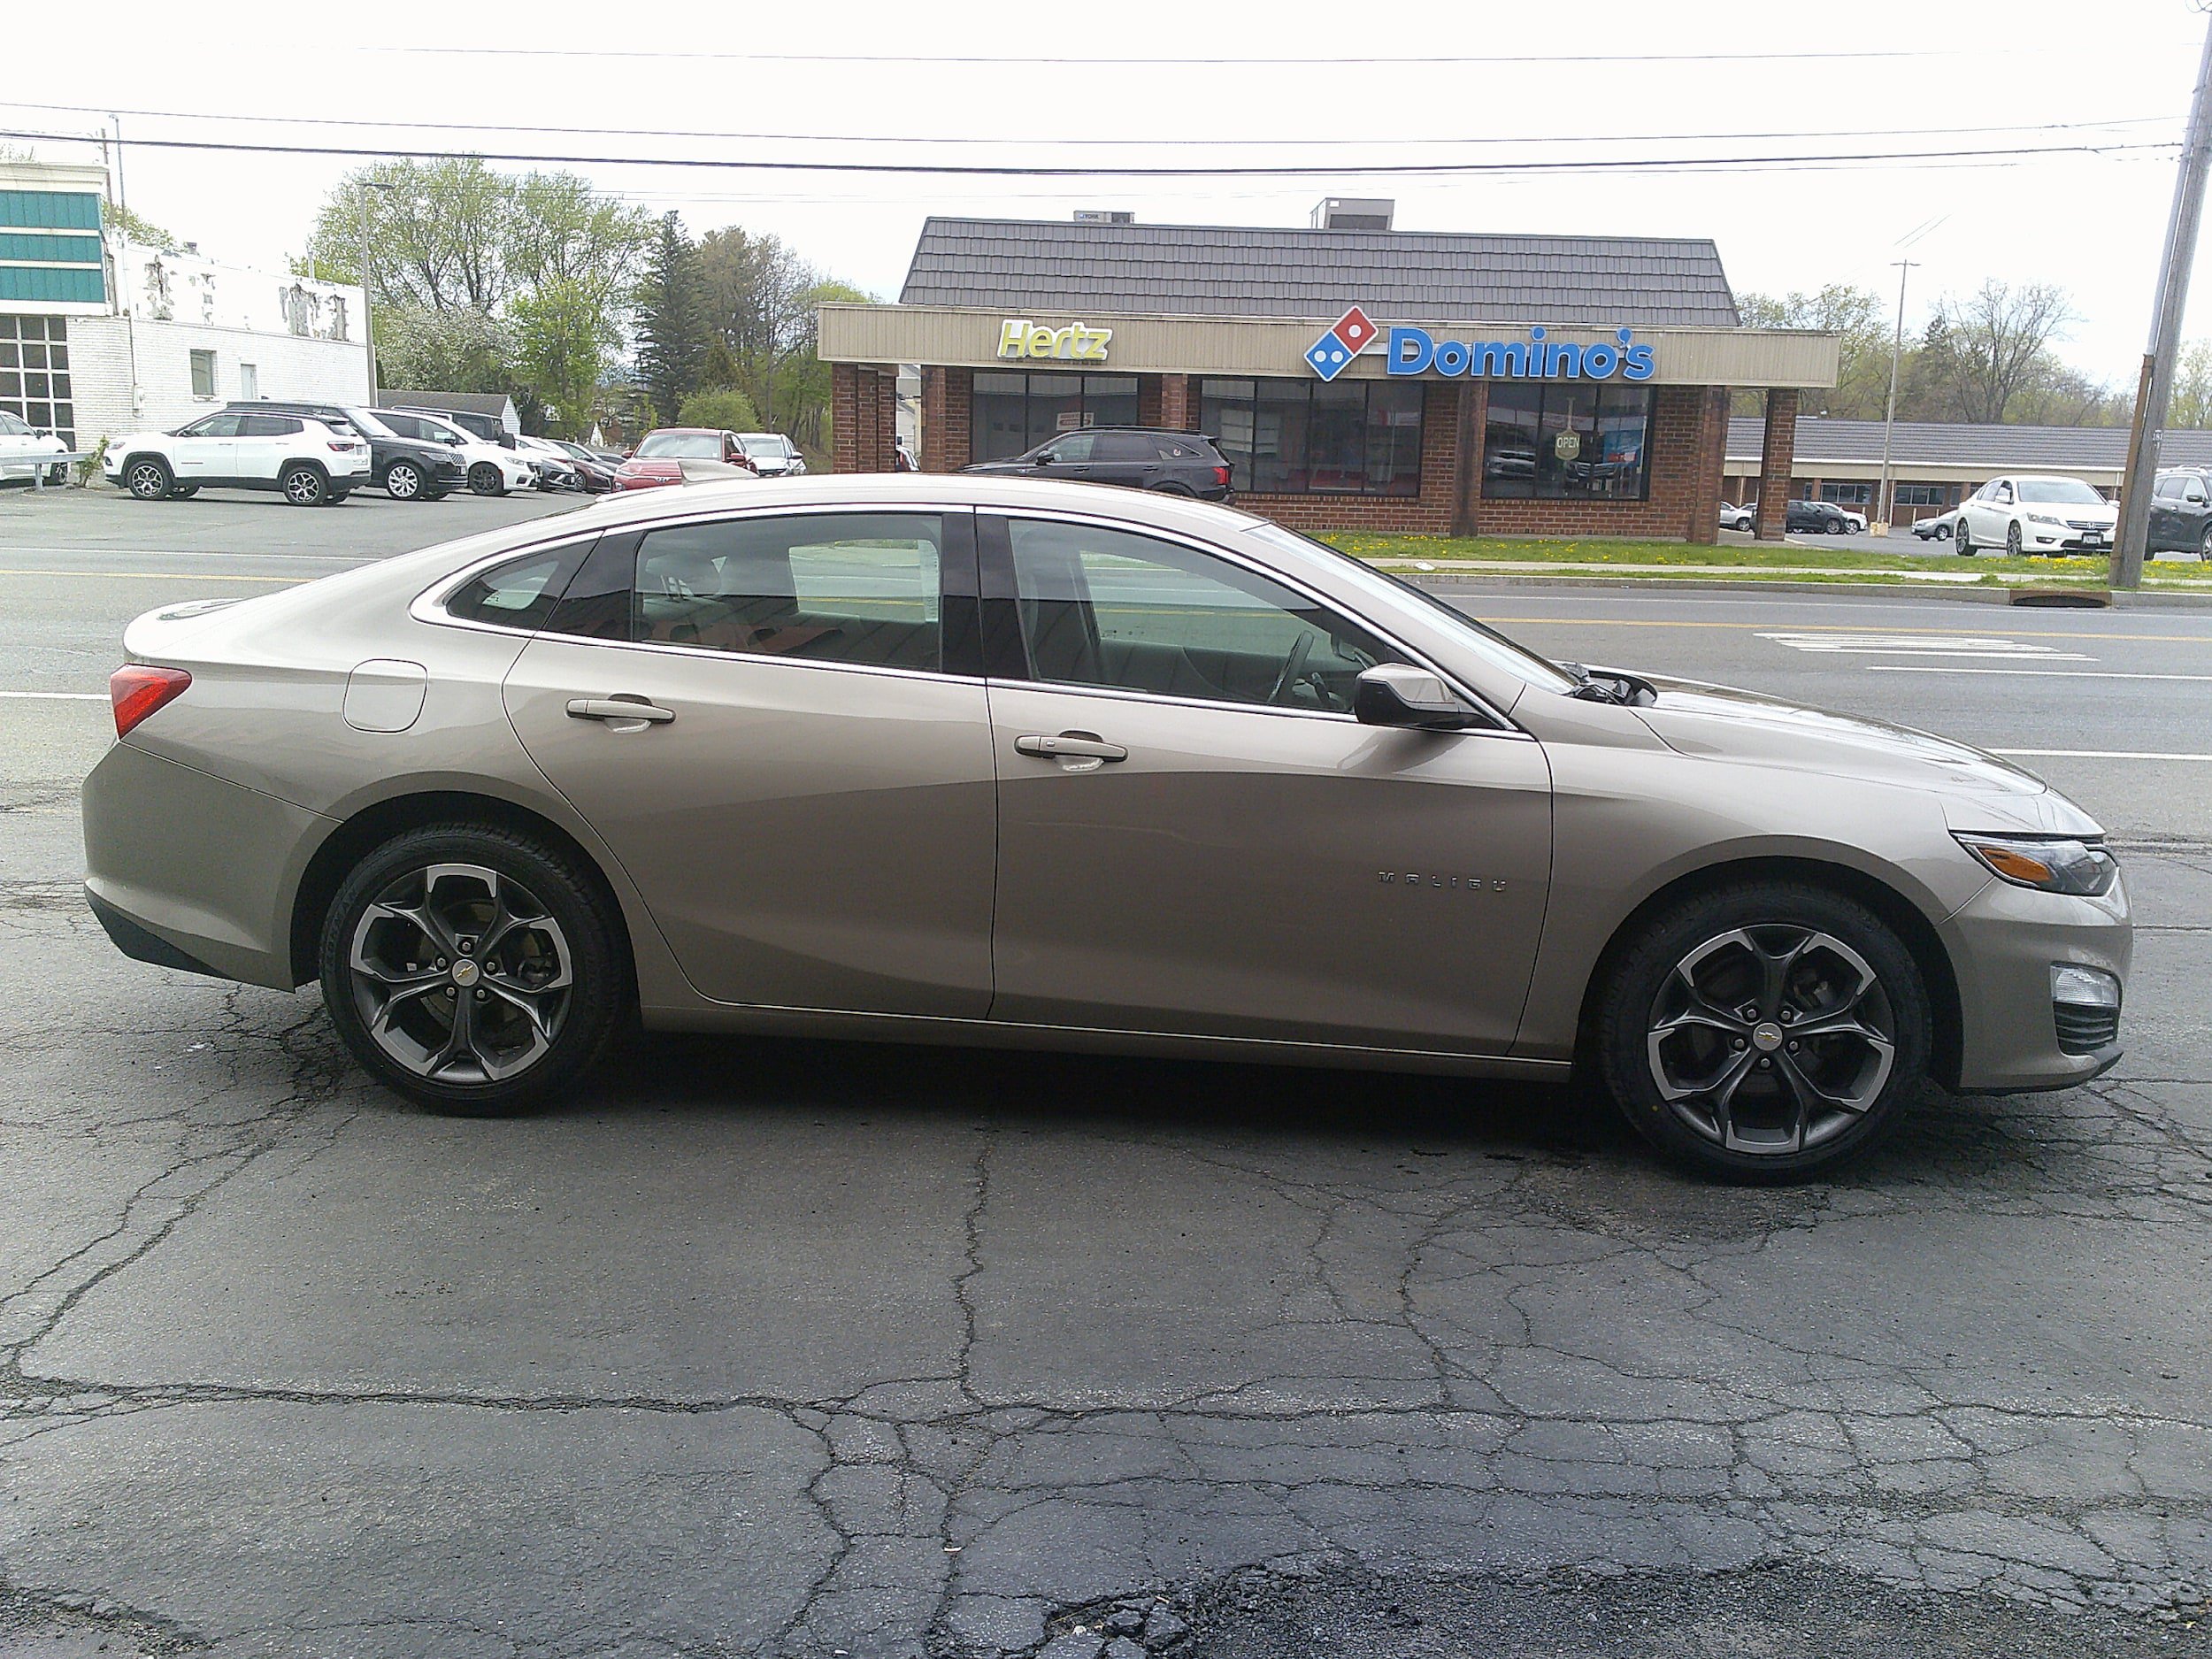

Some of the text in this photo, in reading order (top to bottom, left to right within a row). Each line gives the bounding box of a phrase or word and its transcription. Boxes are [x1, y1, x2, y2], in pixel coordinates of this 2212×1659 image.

[1000, 321, 1110, 359] Hertz
[1386, 326, 1655, 380] Domino's
[1556, 437, 1579, 449] OPEN
[1378, 871, 1506, 892] MALIBU
